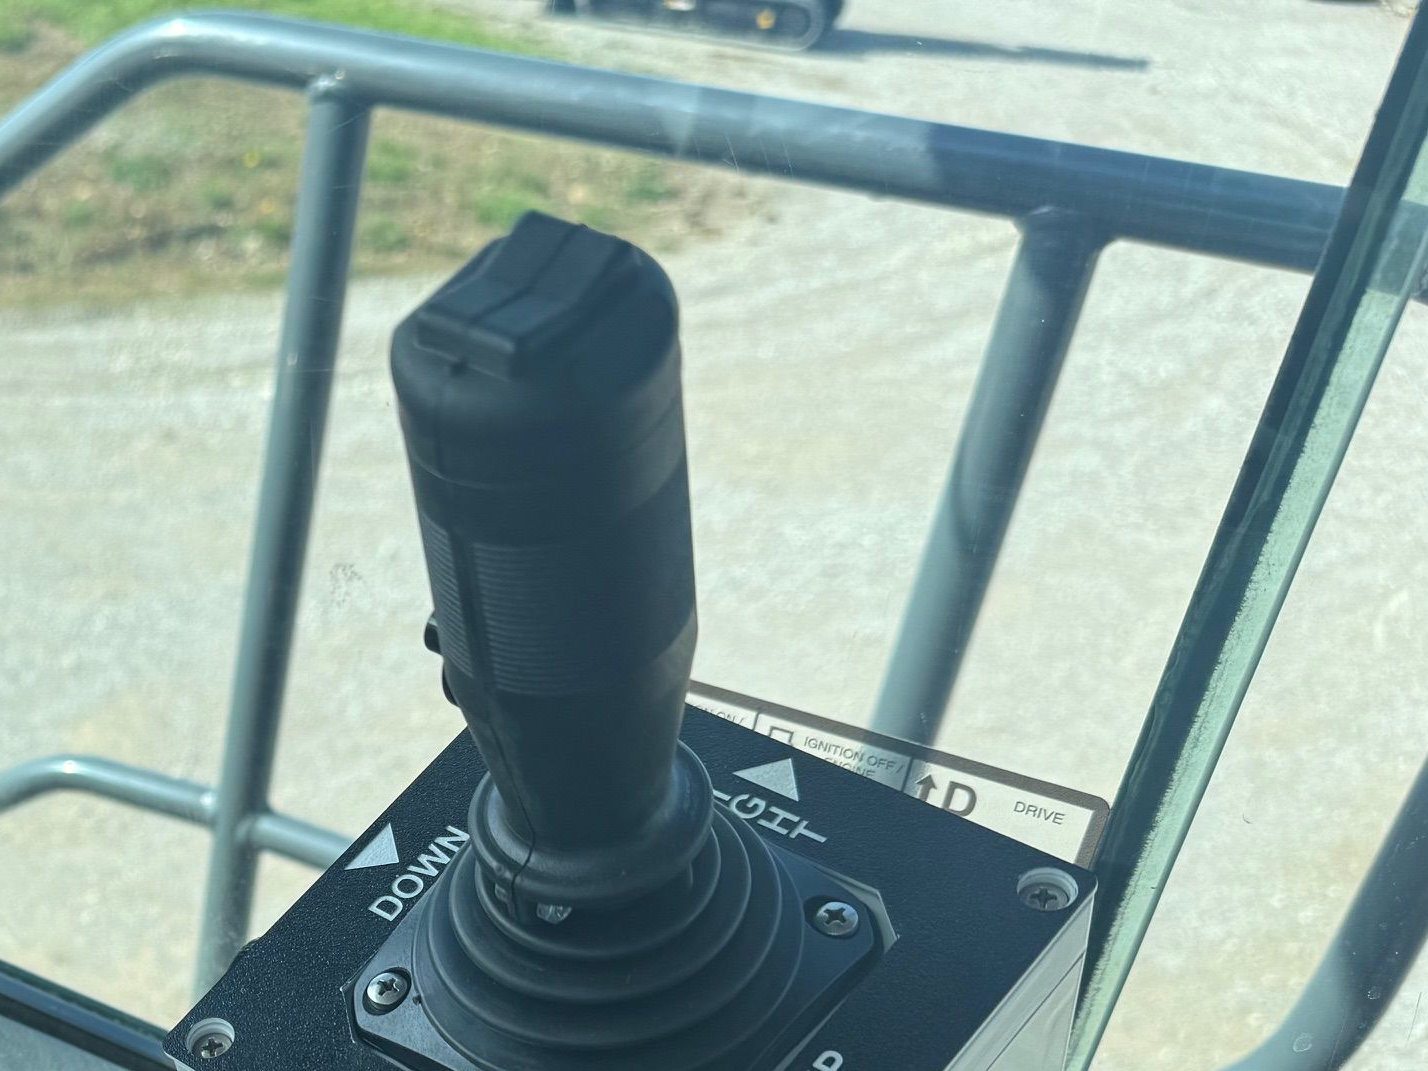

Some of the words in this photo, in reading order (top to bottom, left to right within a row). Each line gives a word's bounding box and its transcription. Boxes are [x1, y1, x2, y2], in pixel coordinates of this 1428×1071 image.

[804, 736, 864, 762] IGNITION
[867, 755, 896, 770] OFF
[713, 788, 827, 843] IGHT
[940, 781, 977, 818] D
[1013, 800, 1066, 825] DRIVE
[368, 826, 472, 921] DOWN
